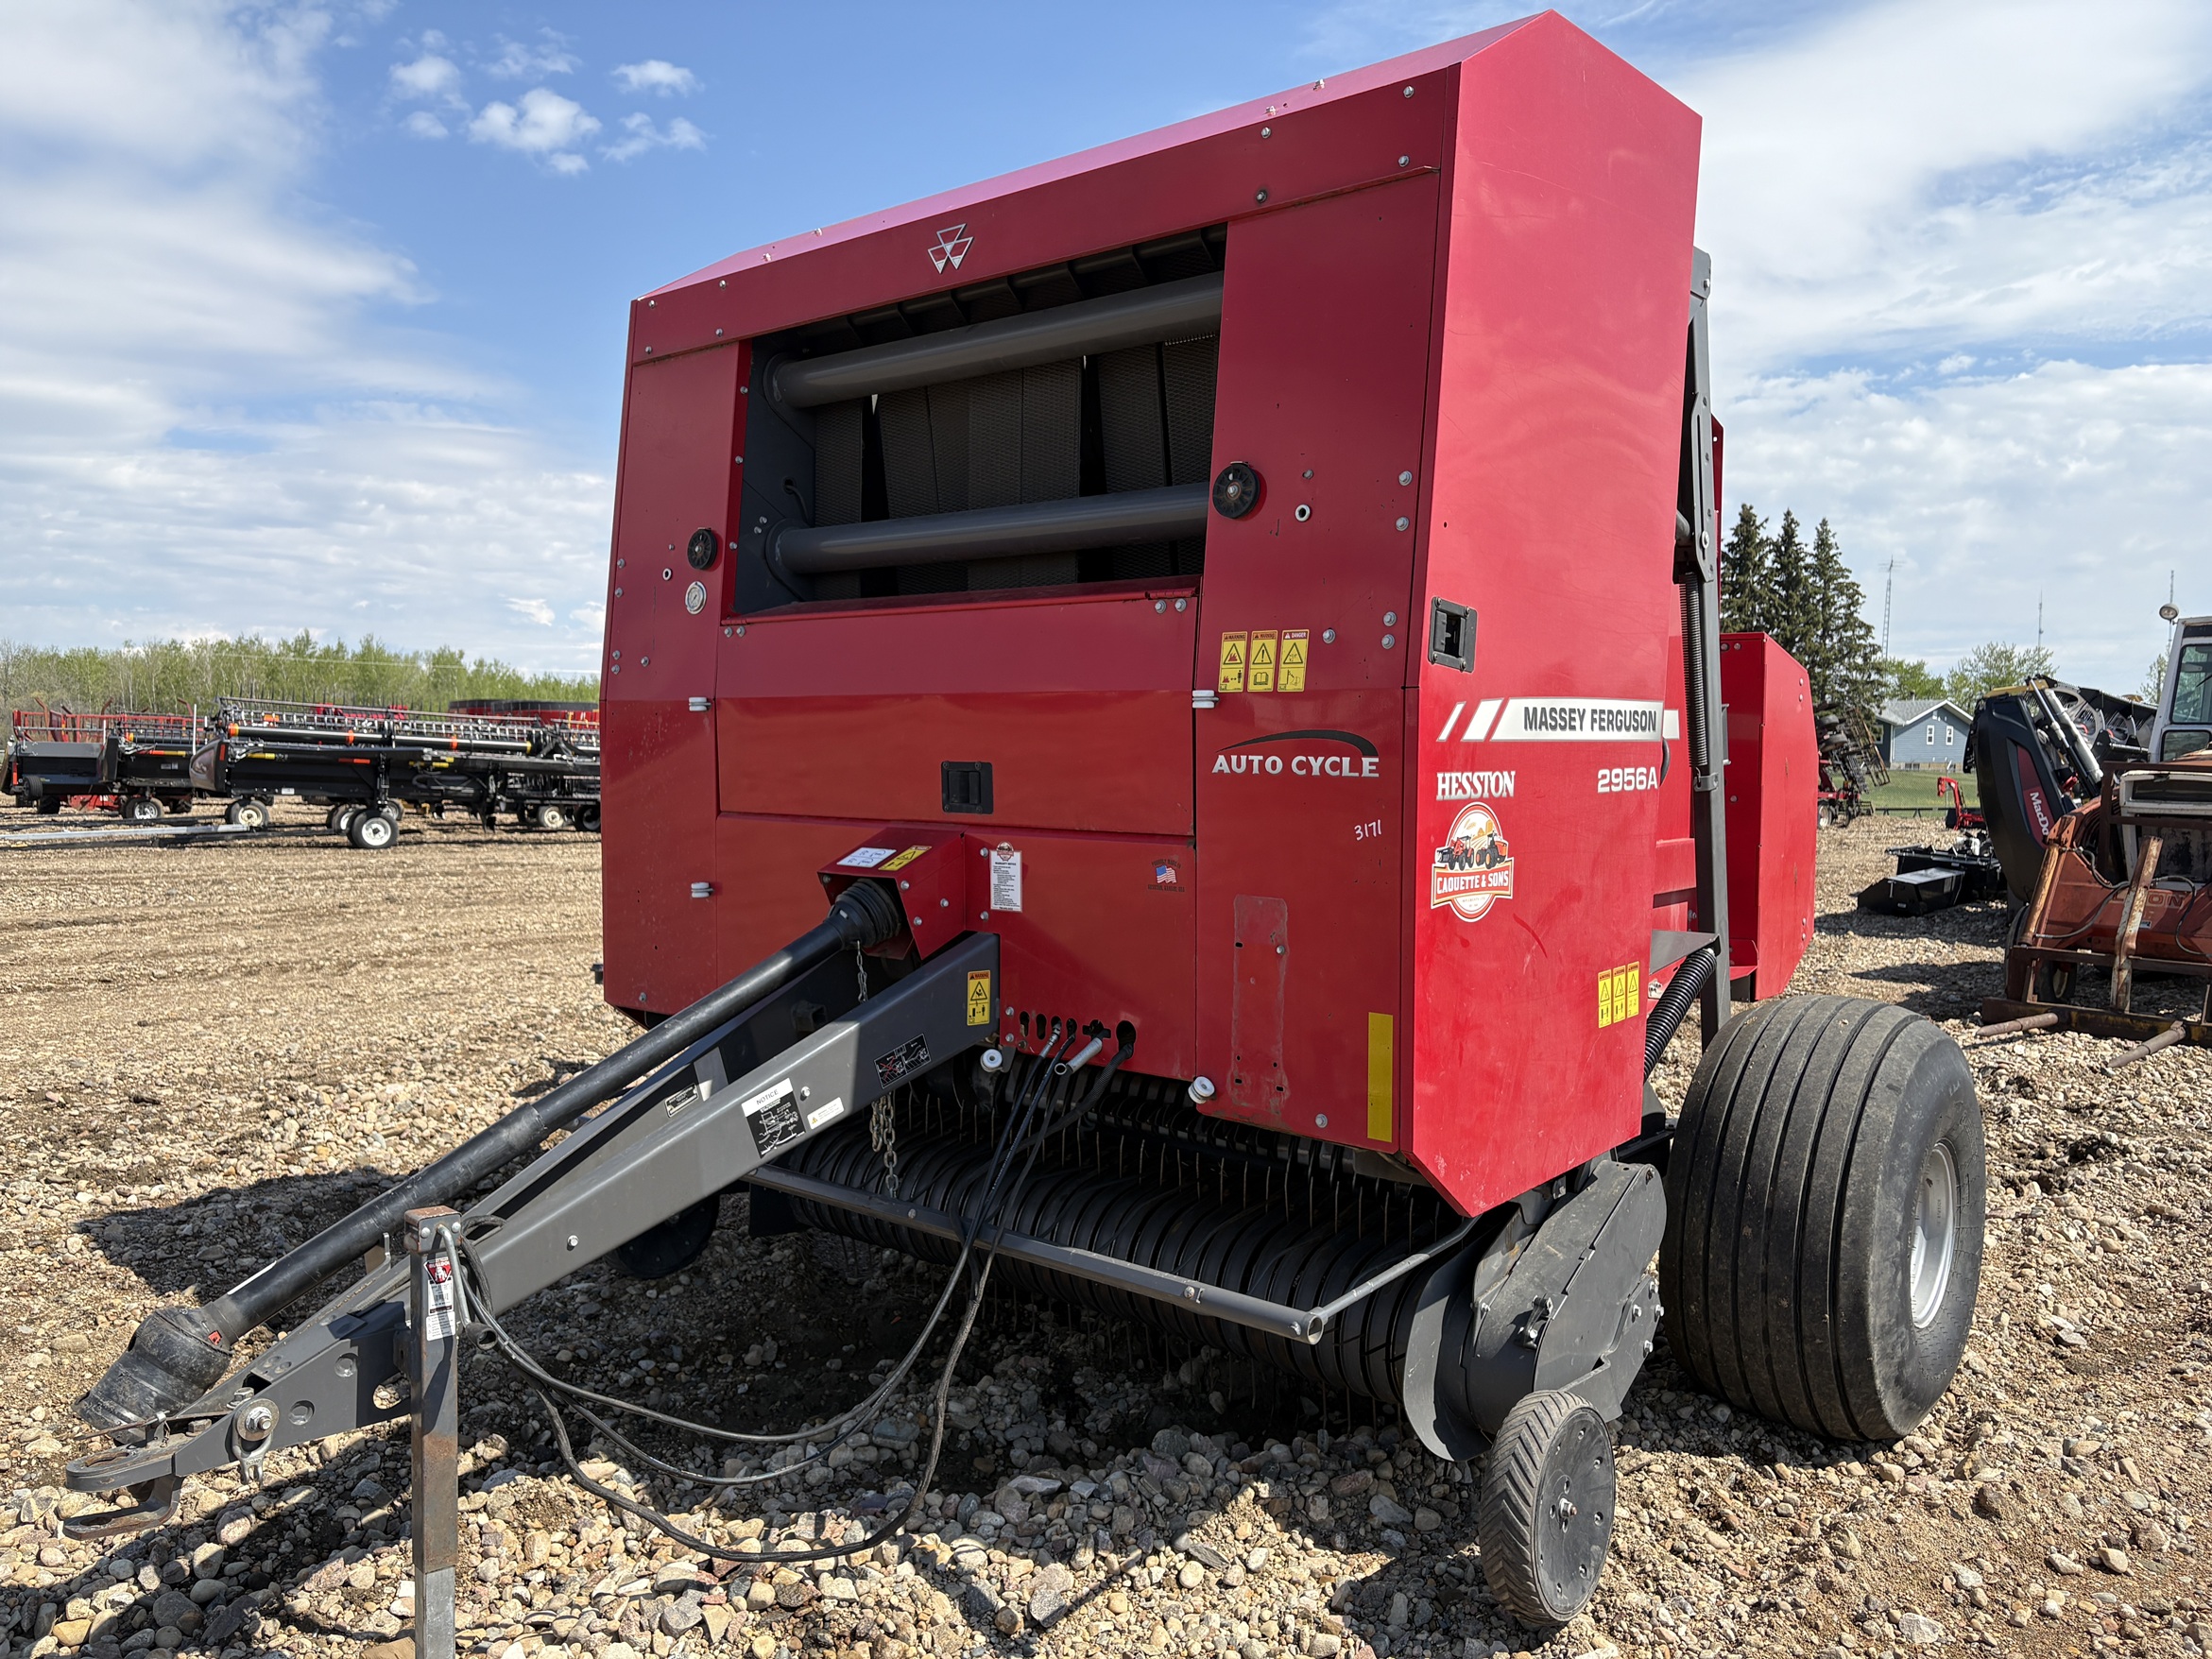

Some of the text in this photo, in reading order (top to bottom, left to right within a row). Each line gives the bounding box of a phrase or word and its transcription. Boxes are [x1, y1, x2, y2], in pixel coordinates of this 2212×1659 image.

[1523, 707, 1657, 732] MASSEY FERGUSON
[1211, 754, 1380, 778] AUTO CYCLE
[1436, 770, 1516, 801] HESSTON
[1597, 766, 1658, 794] 2956A
[2030, 792, 2049, 836] MacDo
[1354, 819, 1381, 841] 3171
[1481, 874, 1487, 888] &
[1488, 870, 1509, 887] SONS
[2113, 890, 2185, 907] LON
[756, 1089, 779, 1105] NOTICE
